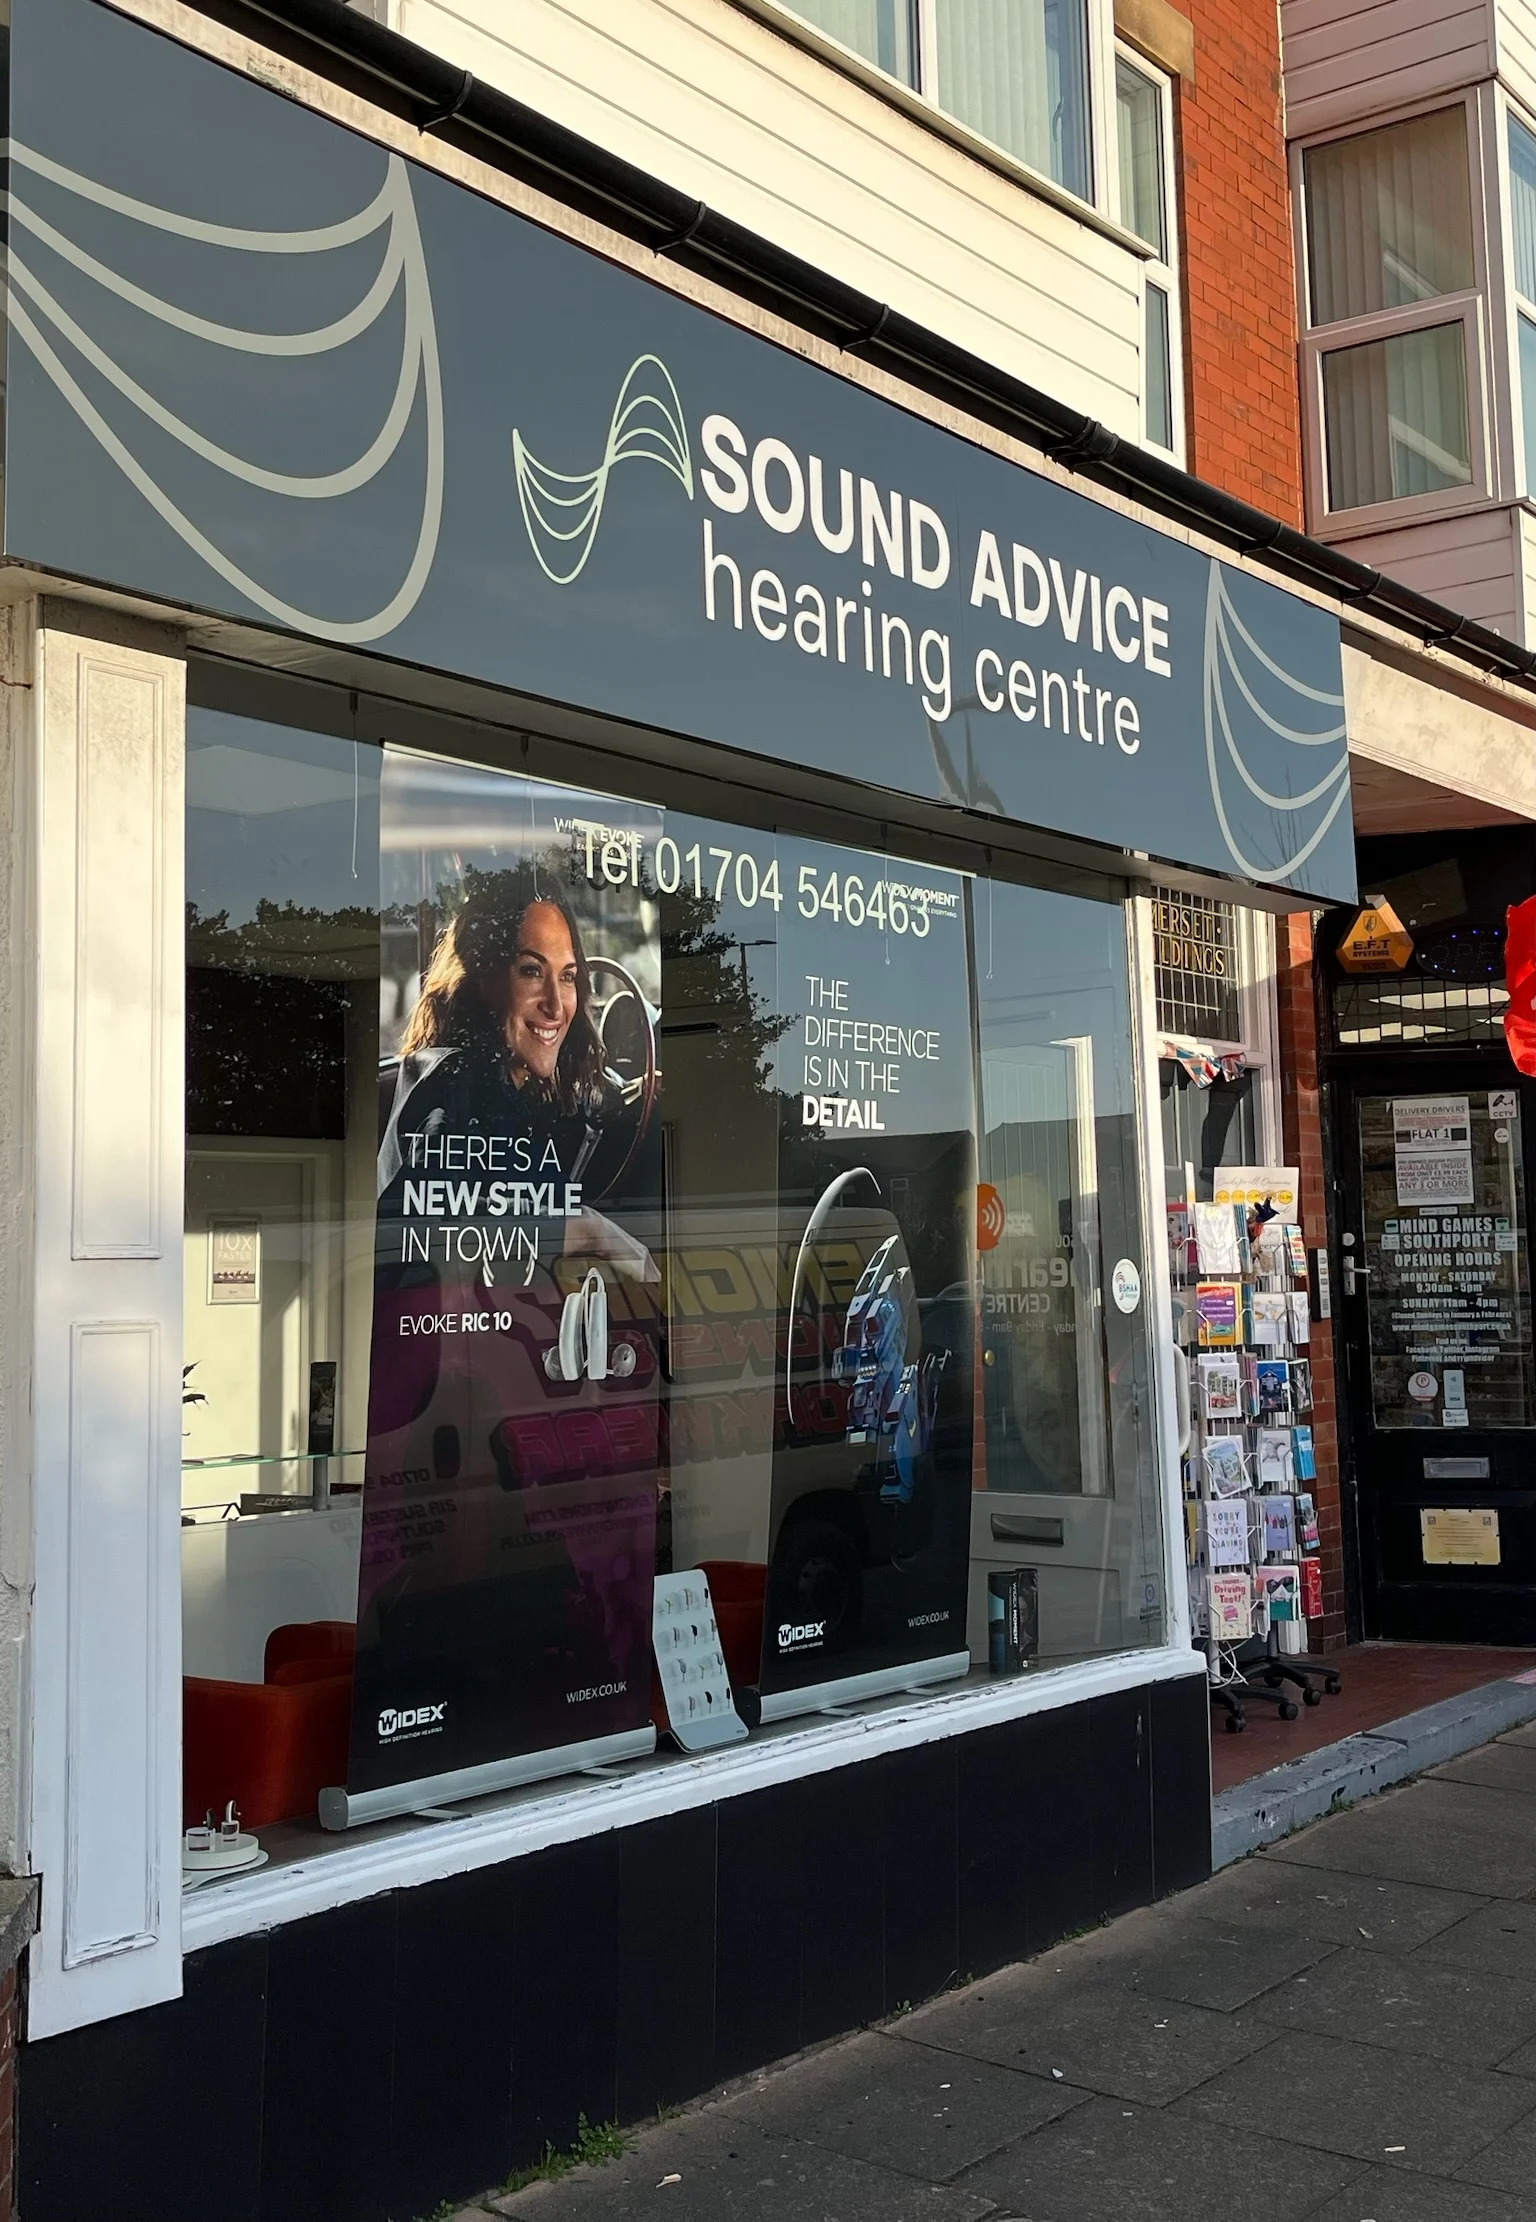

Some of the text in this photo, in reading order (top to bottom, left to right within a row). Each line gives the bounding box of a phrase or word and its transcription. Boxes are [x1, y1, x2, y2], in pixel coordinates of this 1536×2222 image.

[700, 413, 1173, 678] SOUND ADVICE
[703, 518, 1141, 755] hearing centre
[573, 818, 931, 938] Tel 01704 546463
[1352, 949, 1390, 957] SYSTEMS
[805, 975, 849, 1011] THE
[804, 1015, 940, 1061] DIFFERENCE
[804, 1055, 900, 1094] IS IN THE
[802, 1095, 885, 1131] DETAIL
[1394, 1105, 1465, 1116] DELIVERY DRIVERS
[1412, 1128, 1450, 1139] FLAT 1
[404, 1132, 562, 1172] THERE'S A
[1398, 1163, 1438, 1171] AVAILABLE
[403, 1179, 583, 1216] NEW STYLE
[1399, 1218, 1438, 1234] MIND
[1441, 1216, 1493, 1232] GAMES
[401, 1226, 540, 1263] IN TOWN
[1403, 1232, 1490, 1249] SOUTHPORT
[217, 1251, 252, 1261] FASTER
[1394, 1251, 1502, 1268] OPENING HOURS
[1400, 1272, 1440, 1283] MONDAY
[1448, 1271, 1497, 1282] SATURDAY
[1416, 1283, 1453, 1293] 9.30am
[1460, 1282, 1483, 1293] 5pm
[1402, 1298, 1440, 1309] SUNDAY
[1475, 1298, 1498, 1308] 4pm
[400, 1311, 513, 1336] EVOKE RIC 10
[1213, 1512, 1240, 1521] SORRY
[1214, 1585, 1246, 1595] Driving
[907, 1610, 951, 1628] WIDEX.CO.UK
[778, 1622, 825, 1647] WIDEX
[566, 1680, 628, 1704] WIDEX.CO.UK
[378, 1703, 444, 1736] WIDEX
